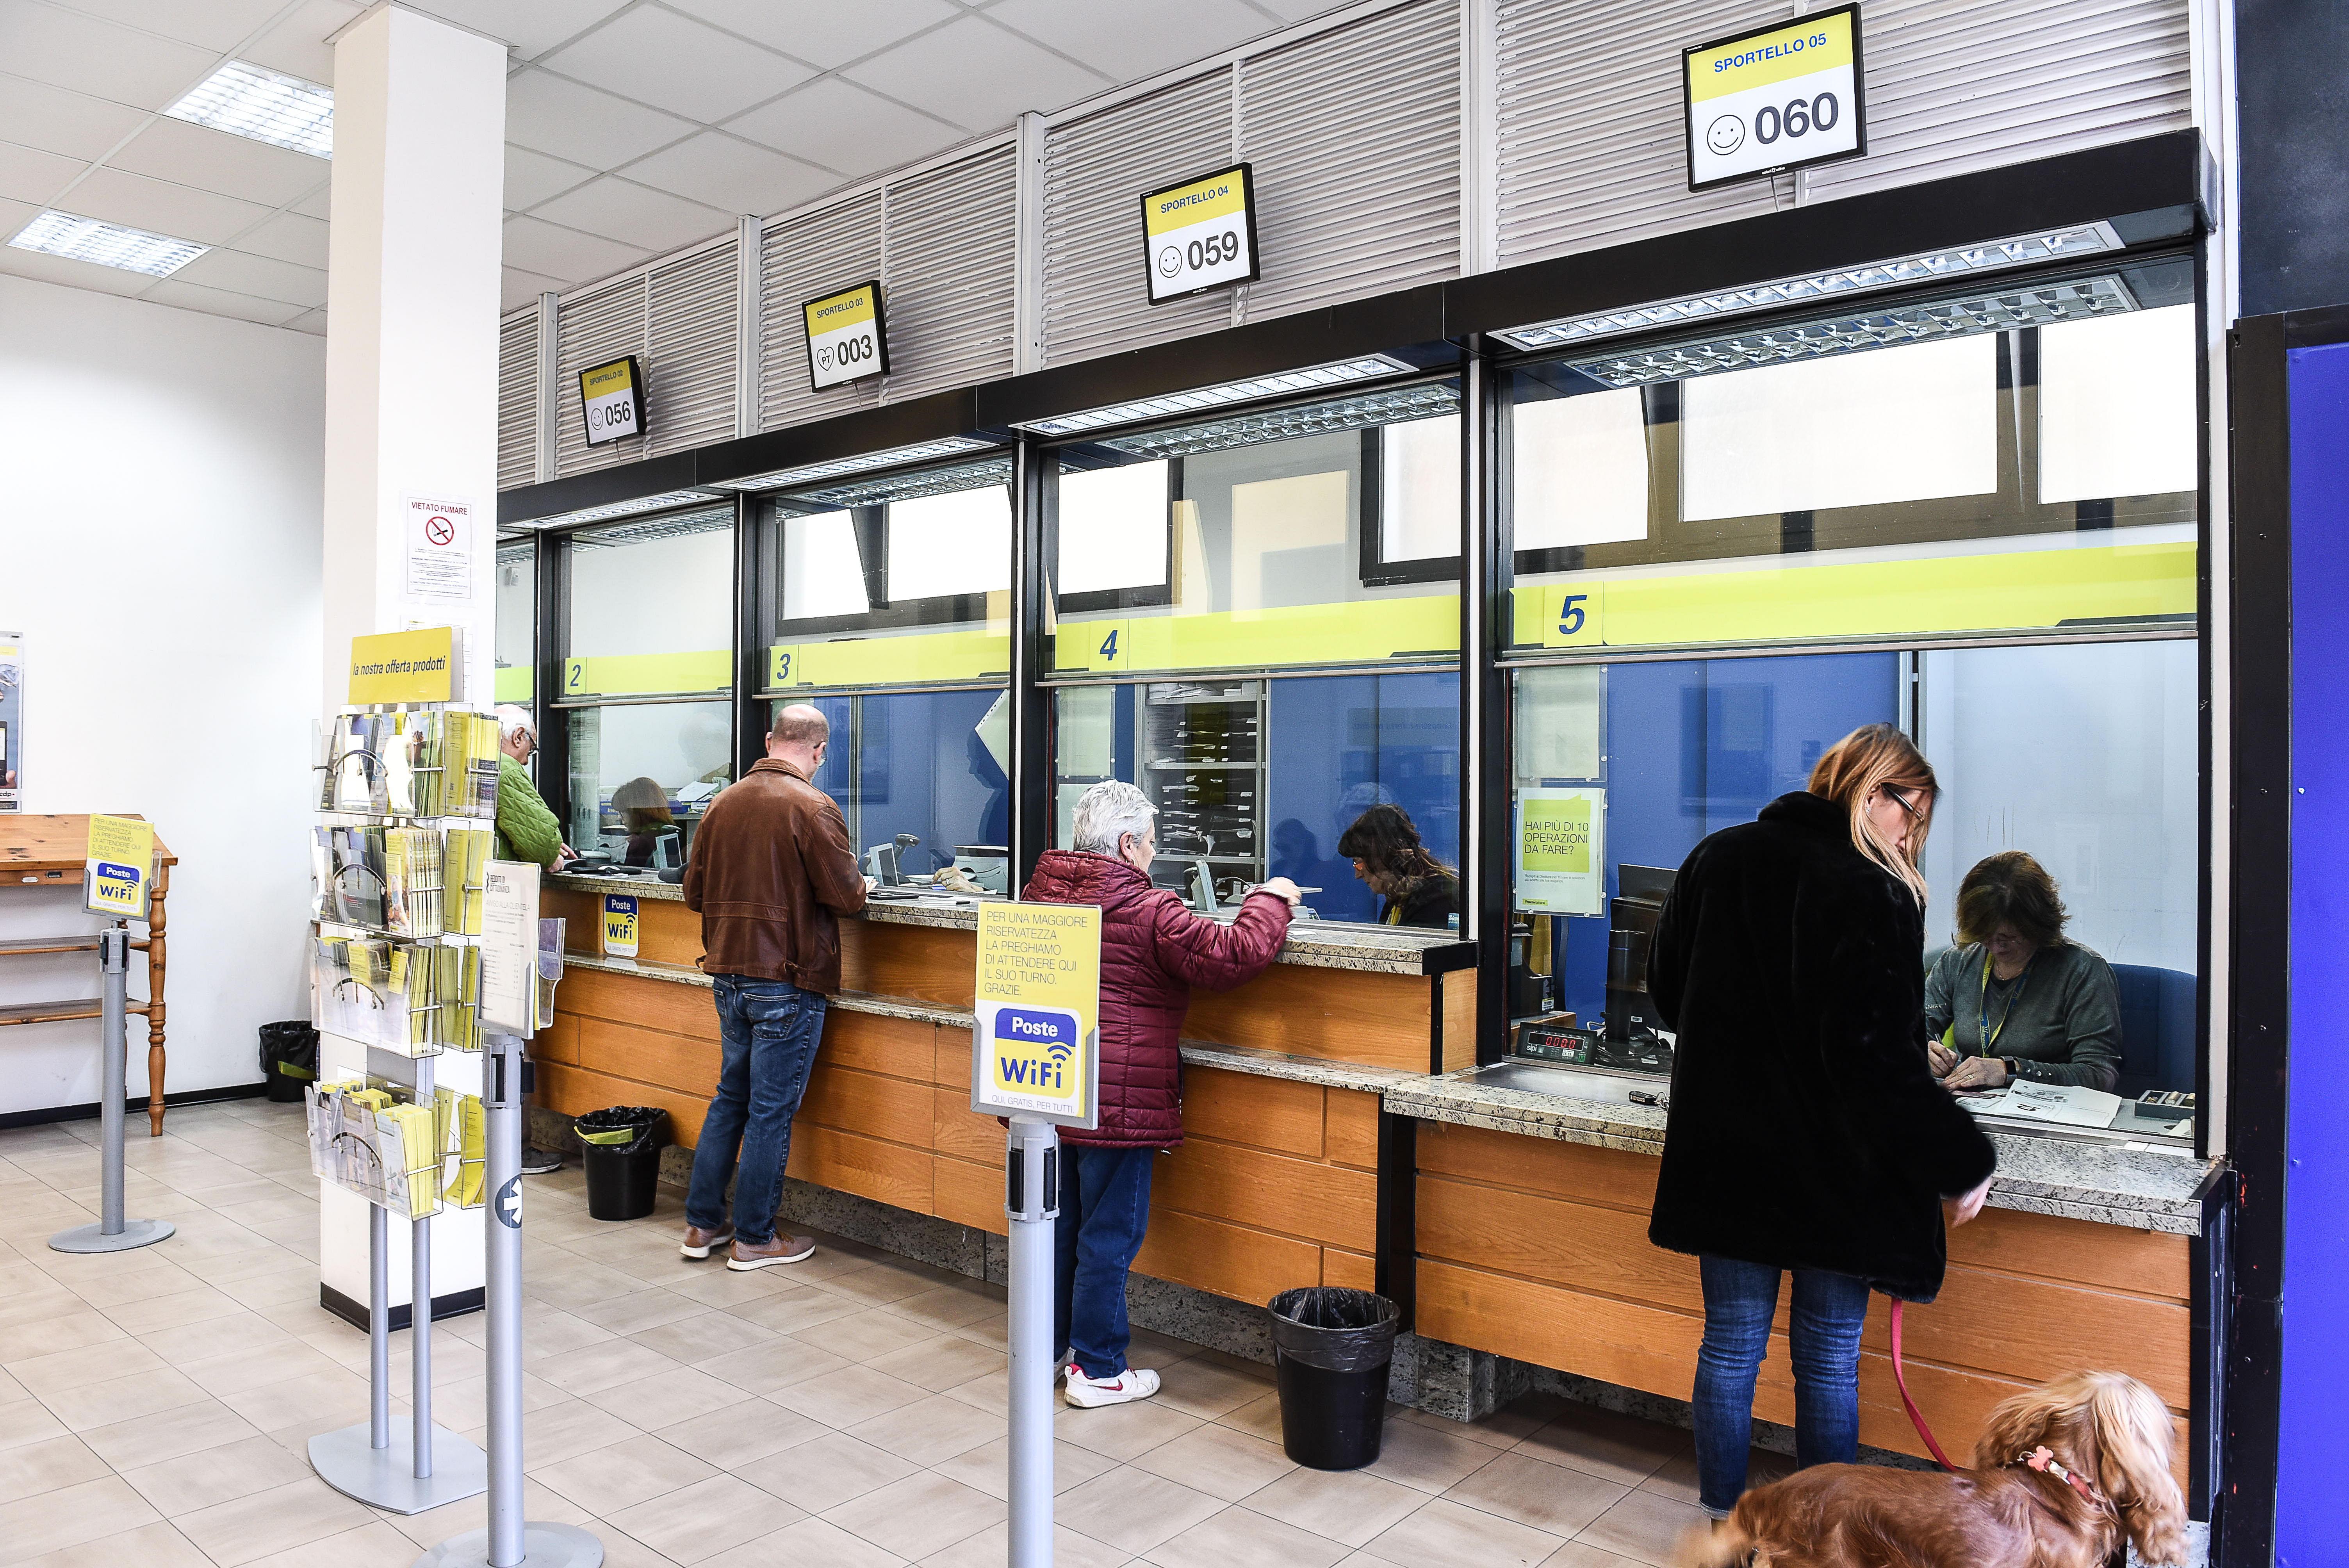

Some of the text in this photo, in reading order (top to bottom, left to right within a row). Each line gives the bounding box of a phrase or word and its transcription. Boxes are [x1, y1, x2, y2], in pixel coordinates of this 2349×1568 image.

[1714, 32, 1827, 73] SPORTELLO 05
[1755, 92, 1839, 144] 060
[1160, 185, 1228, 214] SPORTELLO 04
[1188, 231, 1239, 270] 059
[816, 298, 863, 319] SPORTELLO 03
[838, 335, 873, 366] 003
[822, 355, 830, 365] PT
[590, 371, 617, 385] SPORTELLO
[606, 401, 631, 426] 056
[412, 501, 468, 515] VIETATO FUMARE
[1559, 595, 1588, 634] 5
[1100, 630, 1118, 661] 4
[353, 655, 446, 676] la nostra offerta prodotti
[777, 653, 791, 680] 3
[570, 665, 581, 687] 2
[94, 824, 132, 836] RISERVATEZZA
[119, 822, 147, 832] MAGGIORE
[1525, 820, 1589, 832] HAI PIÙ DI 10
[100, 839, 131, 848] ATTENDERE
[102, 832, 134, 842] PREGHIAMO
[1524, 833, 1588, 844] OPERAZIONI
[1524, 844, 1574, 855] DA FARE?
[106, 867, 131, 878] Poste
[100, 884, 132, 900] WiFi
[612, 899, 631, 910] Poste
[986, 911, 1088, 928] PER UNA MAGGIORE
[608, 923, 632, 940] WiFi
[986, 925, 1057, 940] RISERVATEZZA
[986, 940, 1061, 955] LA PREGHIAMO
[986, 954, 1076, 972] DI ATTENDERE QUI
[985, 968, 1057, 985] IL SUO TURNO.
[984, 982, 1022, 996] GRAZIE.
[1012, 1016, 1058, 1037] Poste
[1526, 1044, 1537, 1052] sipi
[1001, 1057, 1062, 1089] WiFi
[1037, 1101, 1051, 1110] PER
[1052, 1103, 1075, 1114] TUTTI.
